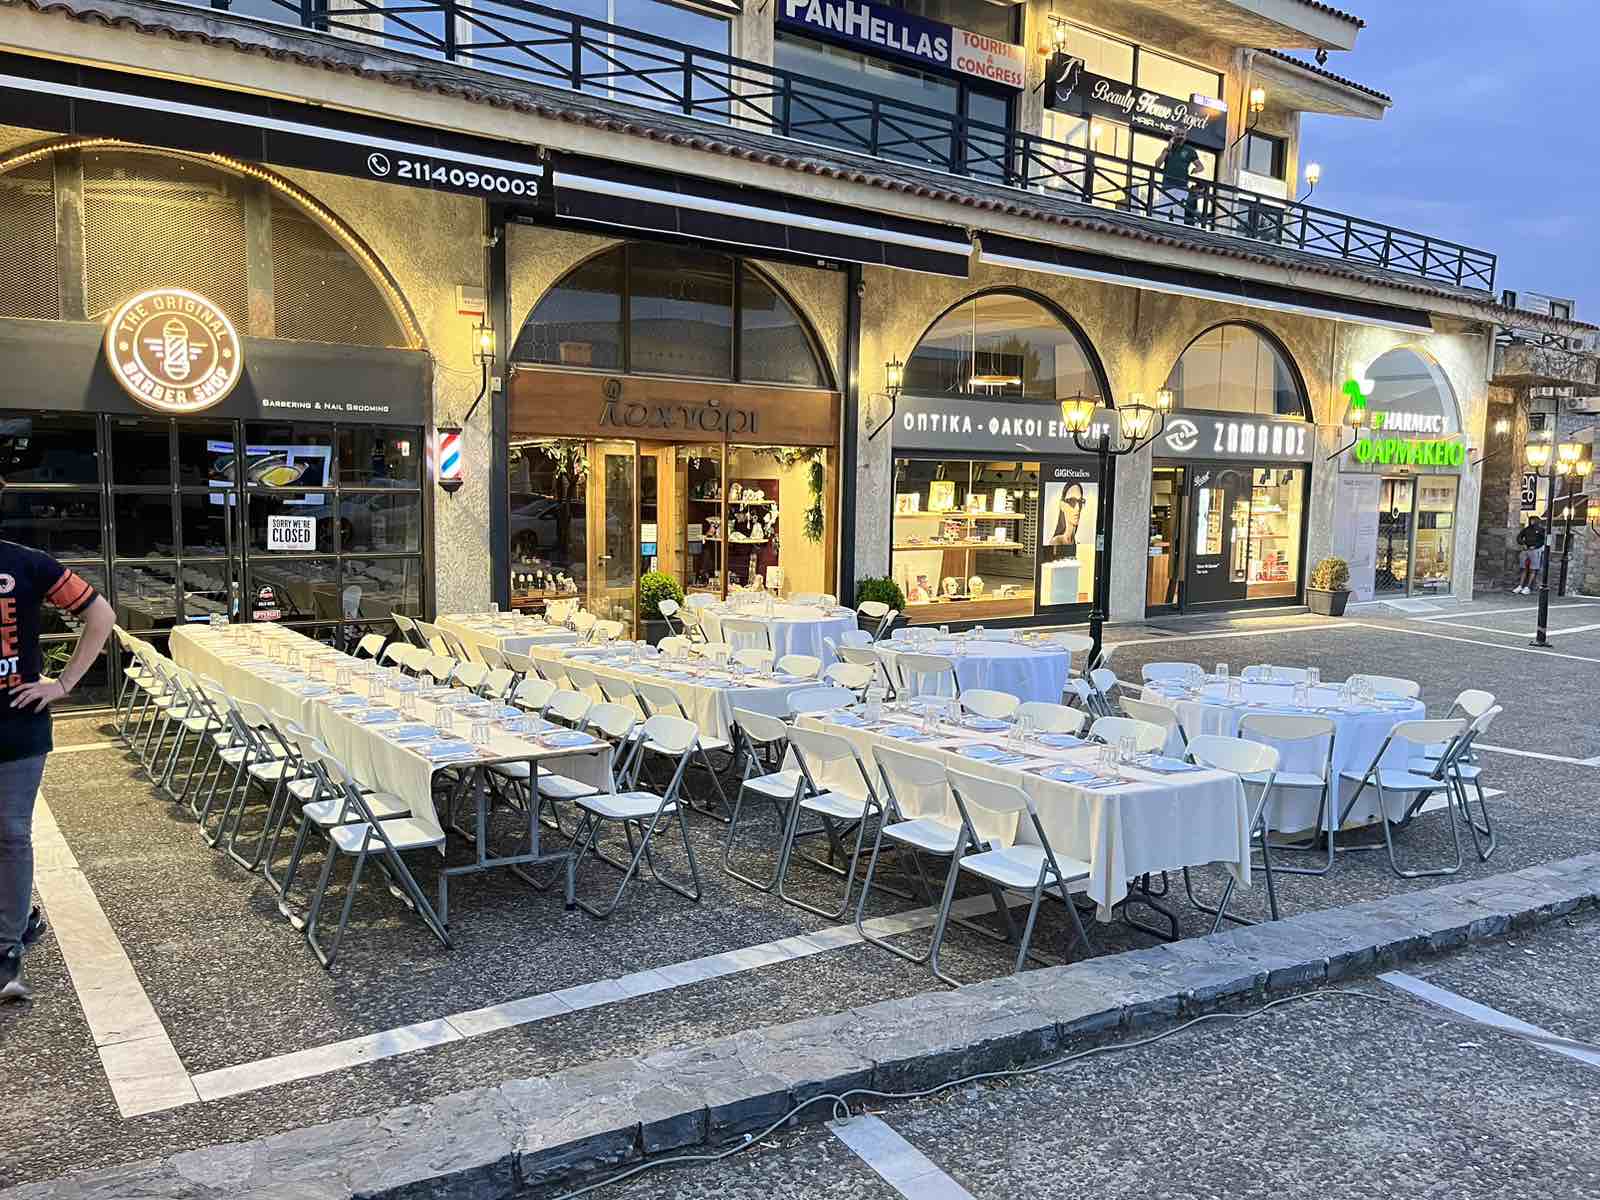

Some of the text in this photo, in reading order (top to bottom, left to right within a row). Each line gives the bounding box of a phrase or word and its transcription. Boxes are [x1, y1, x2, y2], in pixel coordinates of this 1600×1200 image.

[957, 56, 1023, 85] CONGRESS
[1091, 80, 1136, 114] Beauty
[397, 160, 538, 197] 2114090003
[120, 296, 228, 341] THE ORIGINAL
[122, 361, 229, 403] BARBER SHOP
[903, 413, 972, 433] ΟΠΤΙΚΑ
[989, 417, 1042, 437] ΦΑΚΟΙ
[1356, 438, 1465, 465] ΦΑΡΜΑΚΕΙΟ
[272, 519, 311, 528] SORRY WE'RE
[272, 528, 311, 543] CLOSED
